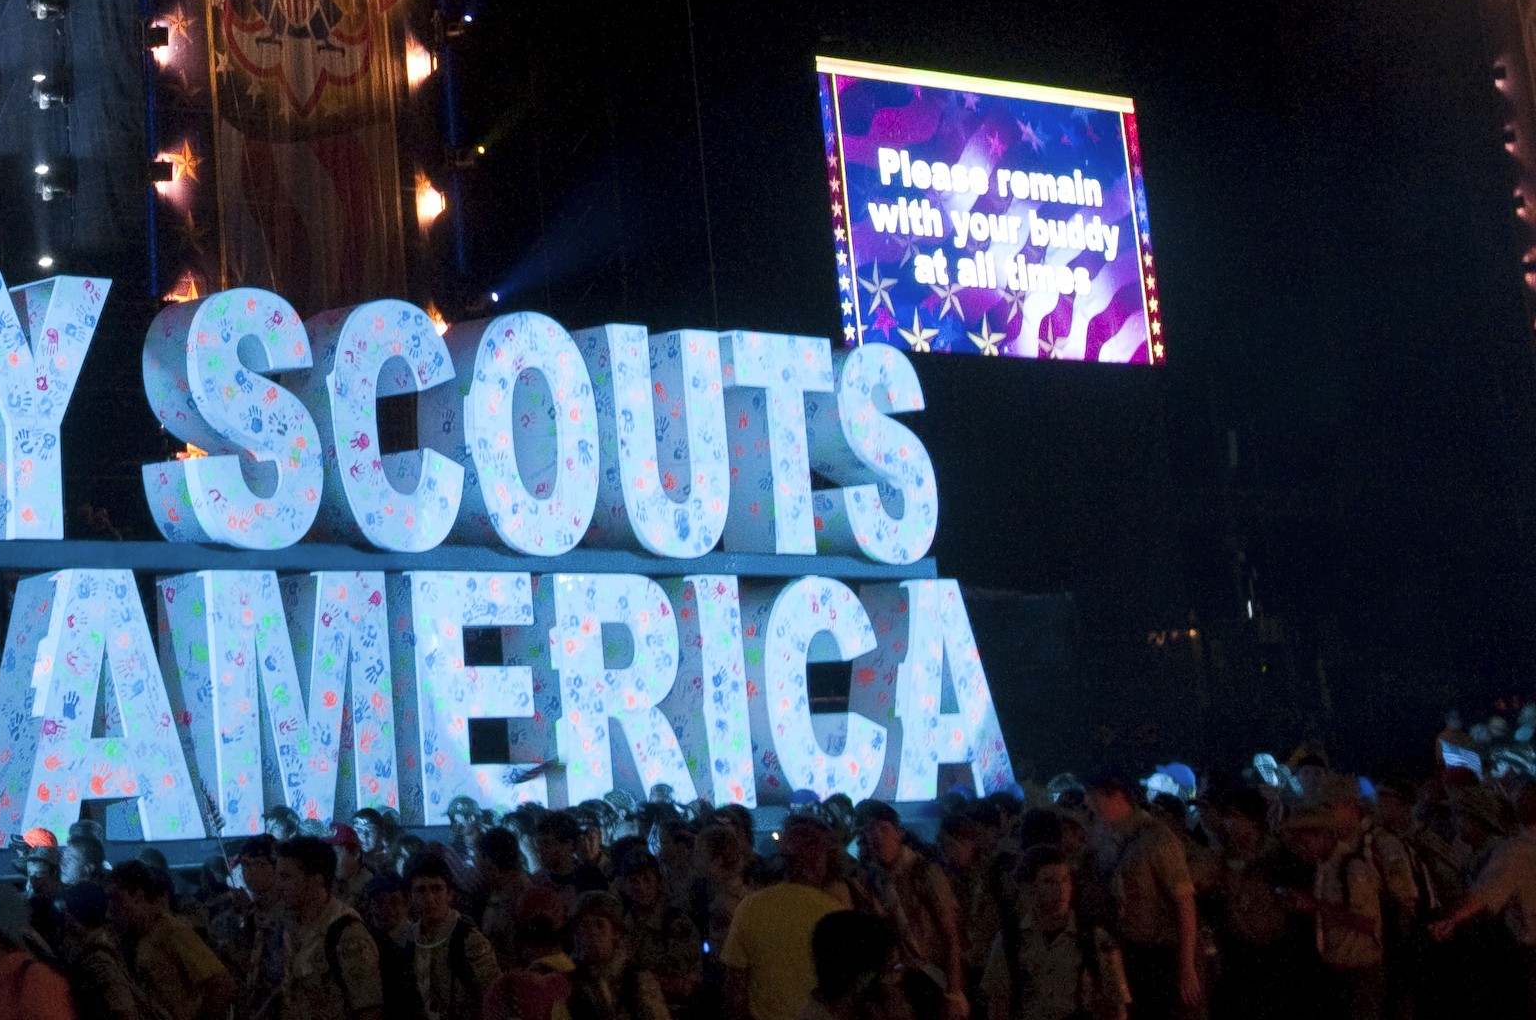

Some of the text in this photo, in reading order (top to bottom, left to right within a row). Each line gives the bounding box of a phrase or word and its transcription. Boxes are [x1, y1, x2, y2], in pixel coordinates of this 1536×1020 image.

[878, 147, 1103, 207] Please remain
[868, 197, 1120, 262] with your buddy
[914, 248, 1092, 296] at all times
[143, 287, 939, 565] SCOUTS
